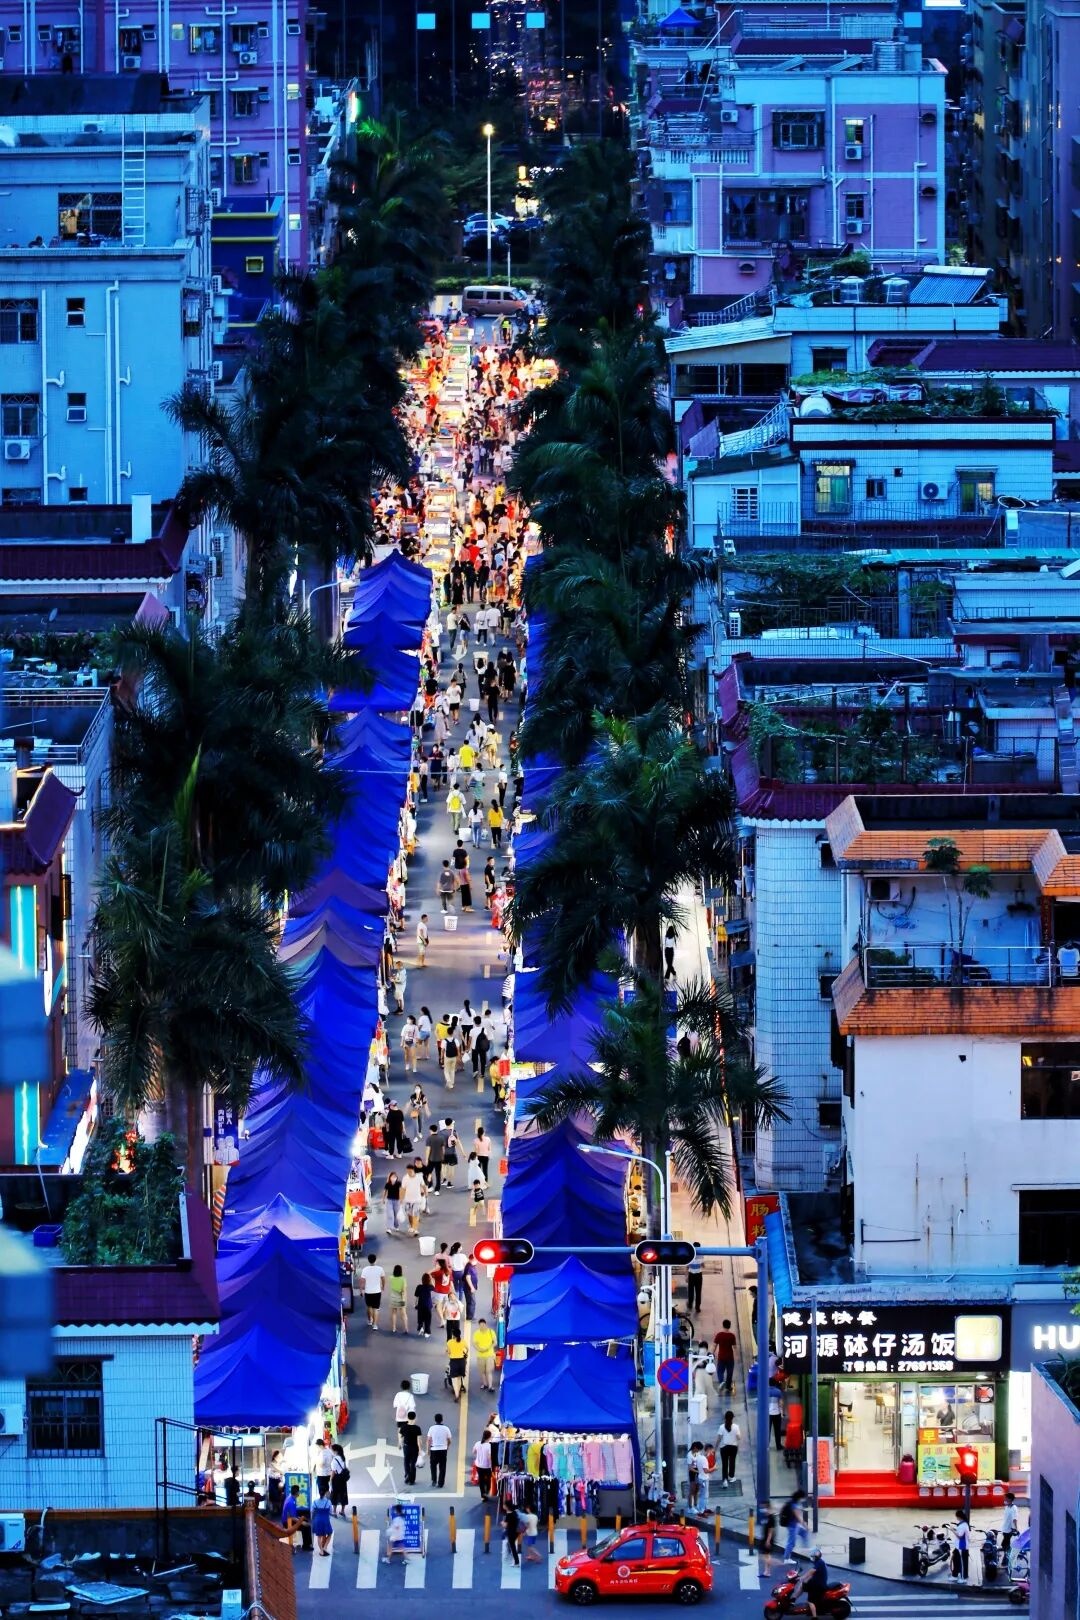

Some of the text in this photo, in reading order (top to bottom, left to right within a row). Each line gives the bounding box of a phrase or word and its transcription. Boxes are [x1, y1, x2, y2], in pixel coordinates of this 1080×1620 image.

[782, 1310, 878, 1326] 健康快餐
[784, 1333, 955, 1358] 河源砵仔汤饭
[1034, 1325, 1080, 1350] HU
